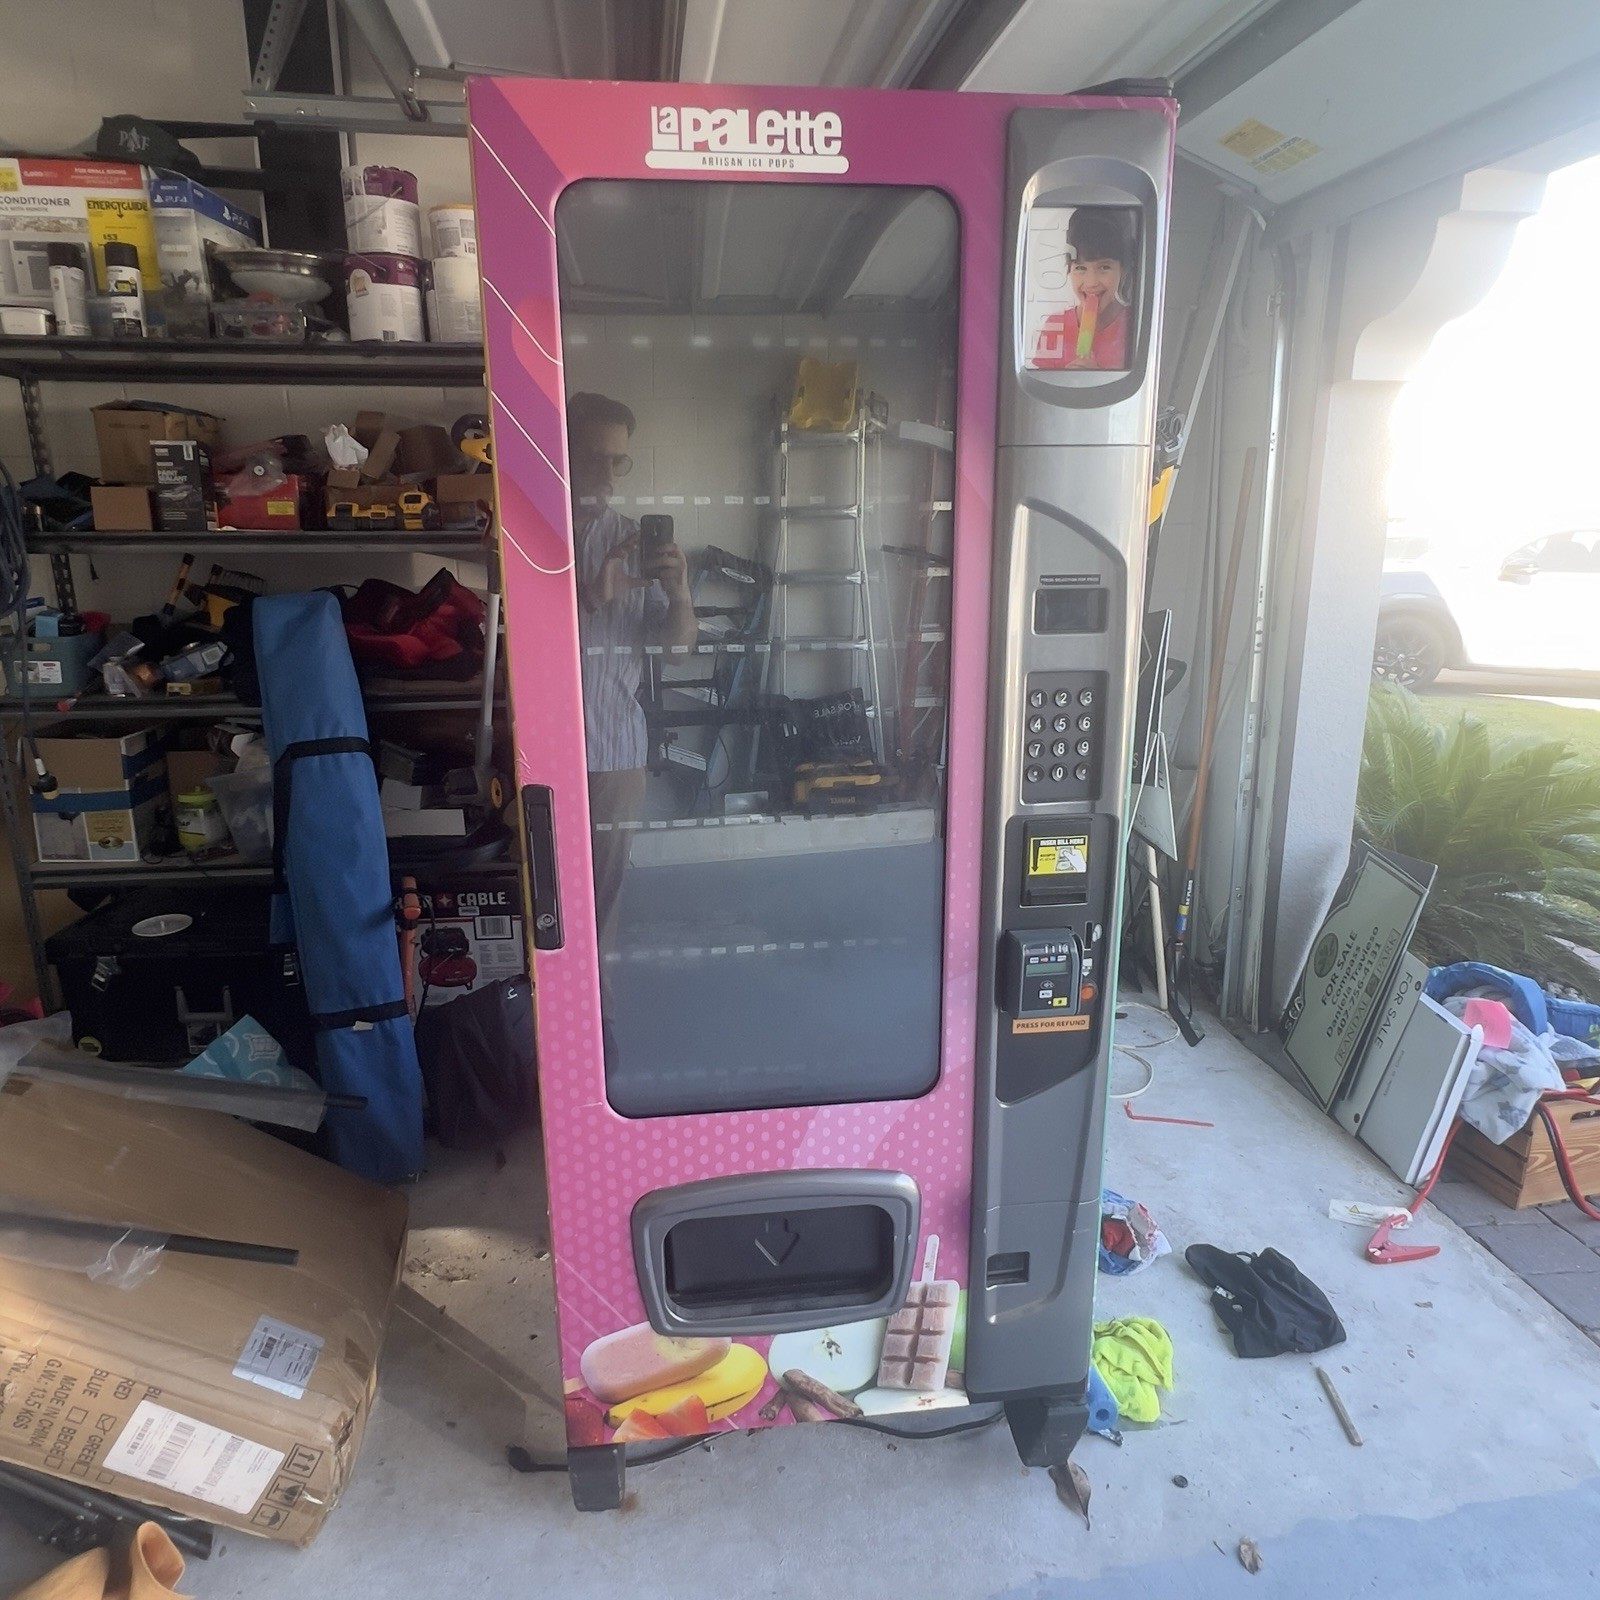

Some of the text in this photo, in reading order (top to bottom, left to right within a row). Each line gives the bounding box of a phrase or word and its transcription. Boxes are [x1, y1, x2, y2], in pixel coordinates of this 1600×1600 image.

[768, 159, 794, 168] POPS
[1036, 692, 1092, 704] 1 2 3
[1034, 716, 1090, 730] 4 5 6
[1034, 741, 1089, 756] 7 8 9
[1056, 767, 1063, 778] 0
[456, 892, 507, 906] CABLE
[1321, 930, 1358, 1006] FOR SALE
[1376, 936, 1398, 975] PARK
[1326, 926, 1379, 1038] Daniela Travieso
[1332, 946, 1361, 1006] Compass
[1336, 942, 1382, 1037] 407-756-4131
[1374, 972, 1413, 1049] FOR SALE
[82, 1368, 110, 1398] BLUE
[114, 1376, 136, 1400] RED
[25, 1386, 48, 1409] 13.5
[13, 1408, 36, 1430] KGS
[28, 1375, 78, 1448] MADE IN CHINA
[50, 1426, 77, 1458] BEIGE
